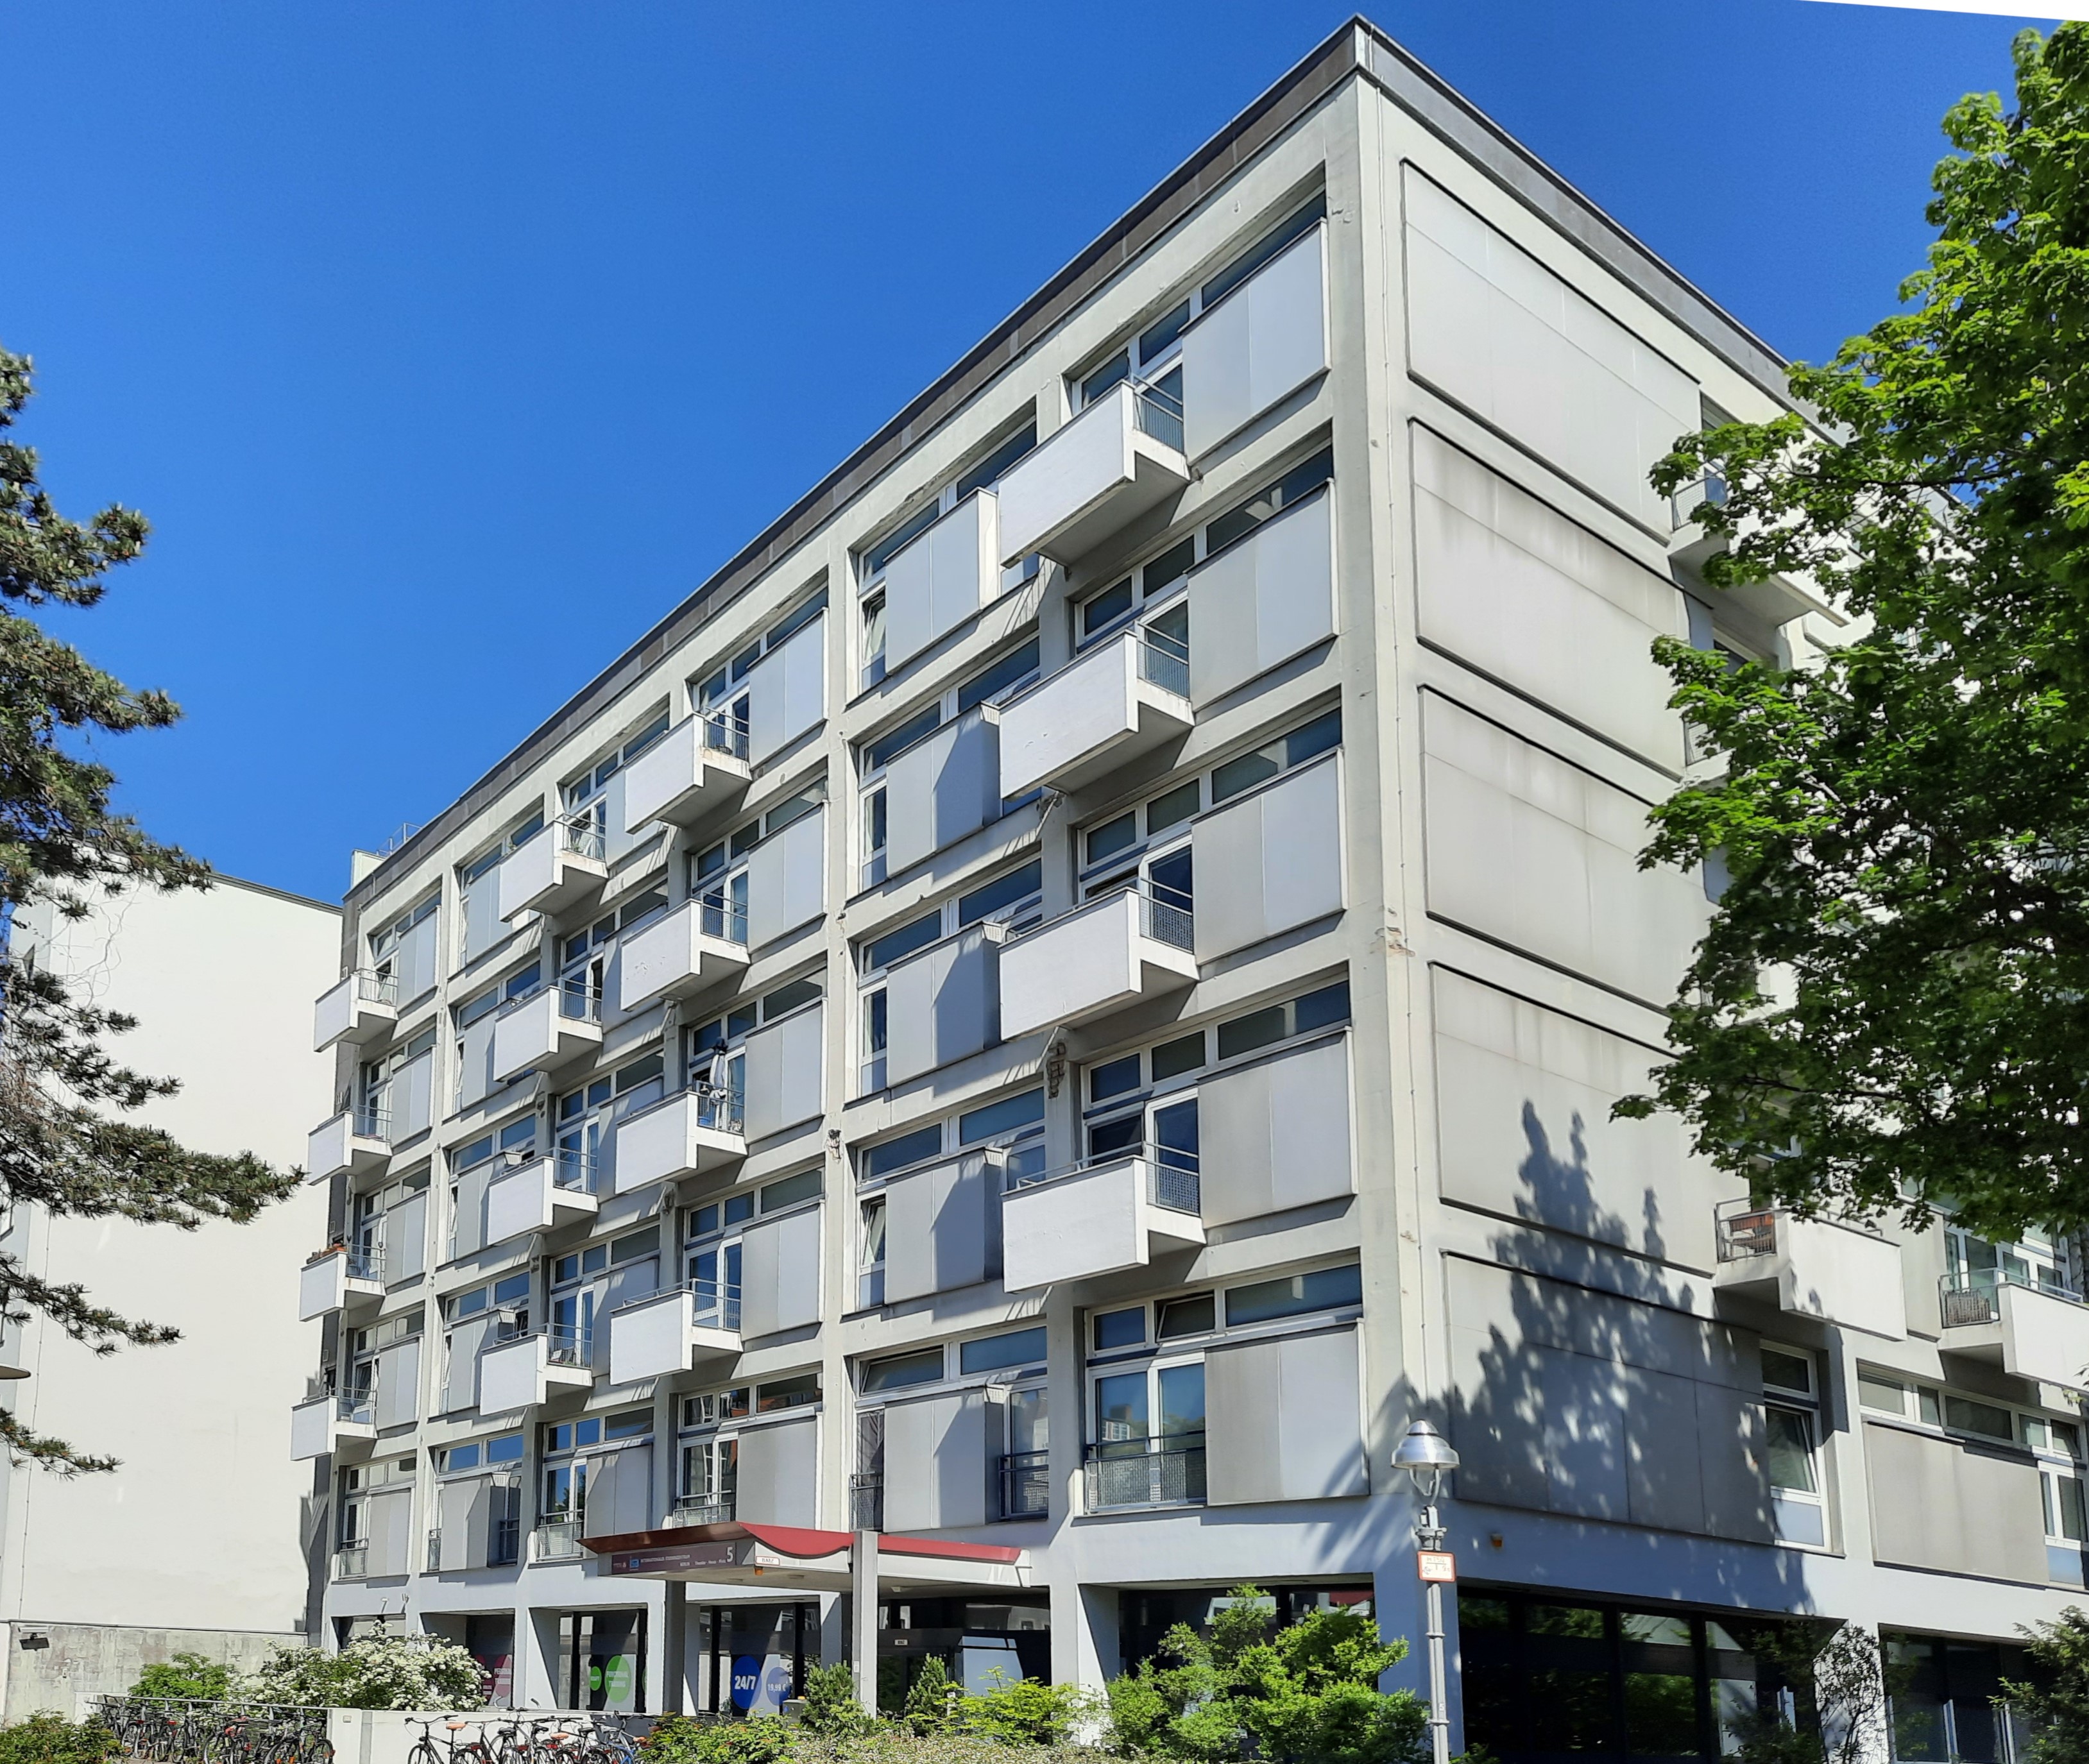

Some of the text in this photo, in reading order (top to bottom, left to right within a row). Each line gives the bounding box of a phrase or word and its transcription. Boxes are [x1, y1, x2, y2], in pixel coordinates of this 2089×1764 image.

[726, 1546, 733, 1563] 5
[734, 1675, 756, 1690] 24/7
[767, 1683, 781, 1692] 19,99
